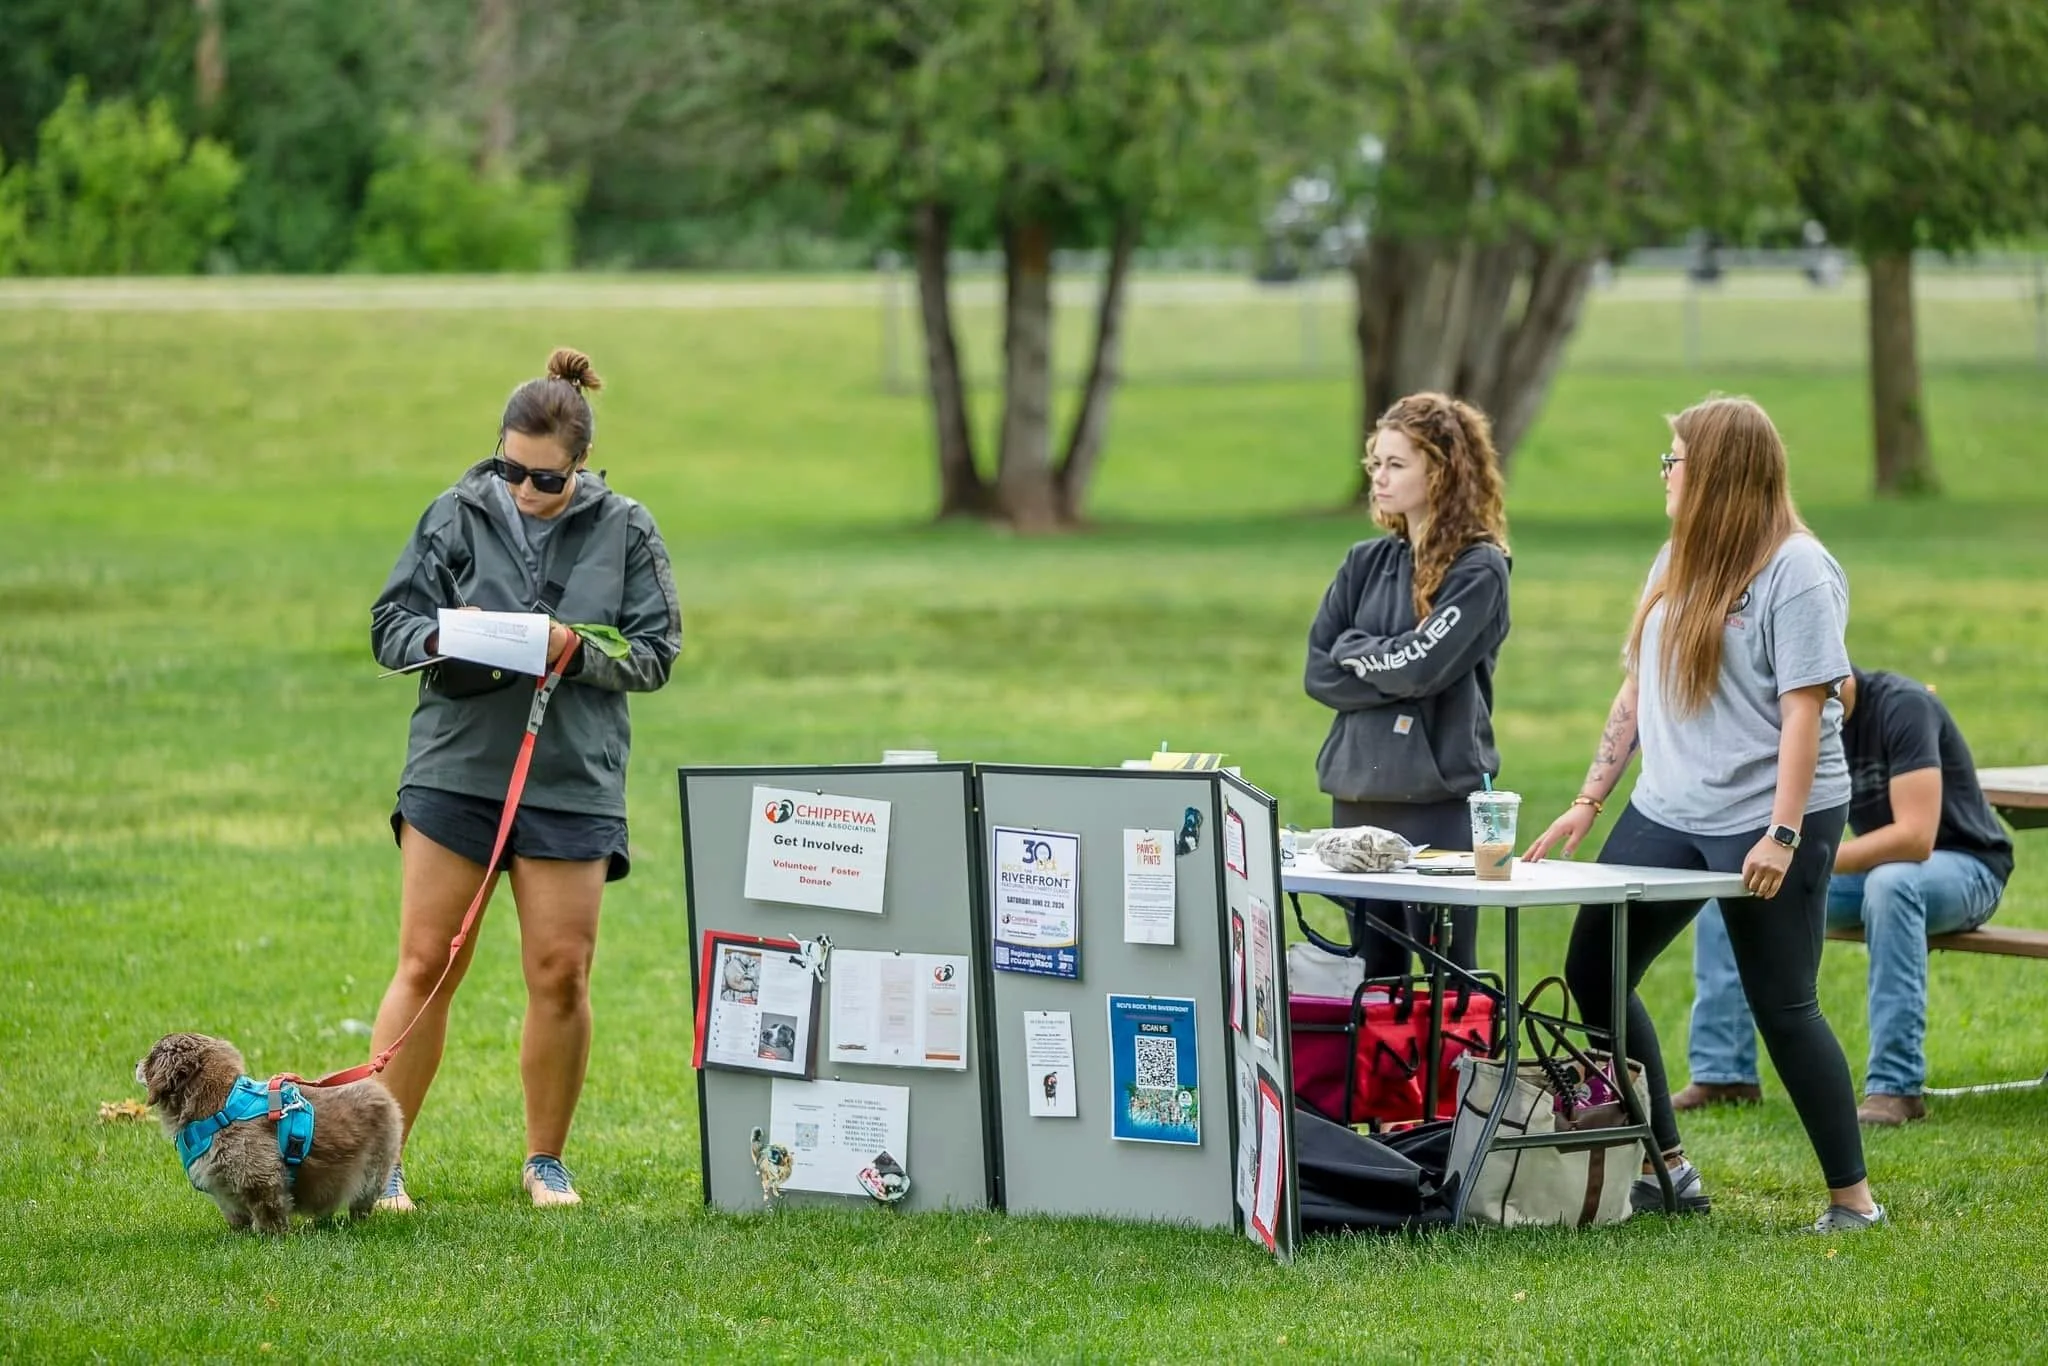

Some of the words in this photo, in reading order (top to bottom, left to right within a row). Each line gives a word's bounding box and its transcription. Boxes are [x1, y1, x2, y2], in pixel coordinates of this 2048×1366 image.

[796, 804, 876, 825] CHIPPEWA
[794, 819, 825, 828] HUMANE
[827, 822, 876, 833] ASSOCIATION
[773, 834, 798, 847] Get
[802, 837, 863, 854] Involved:
[1022, 839, 1051, 863] 30
[1136, 844, 1154, 854] PAWS
[1143, 855, 1161, 865] PINTS
[772, 859, 817, 871] Volunteer
[831, 866, 860, 877] Foster
[799, 876, 832, 887] Donate
[1001, 871, 1071, 888] RIVERFRONT
[1006, 896, 1031, 905] SATURDAY
[1141, 1023, 1159, 1032] SCAN
